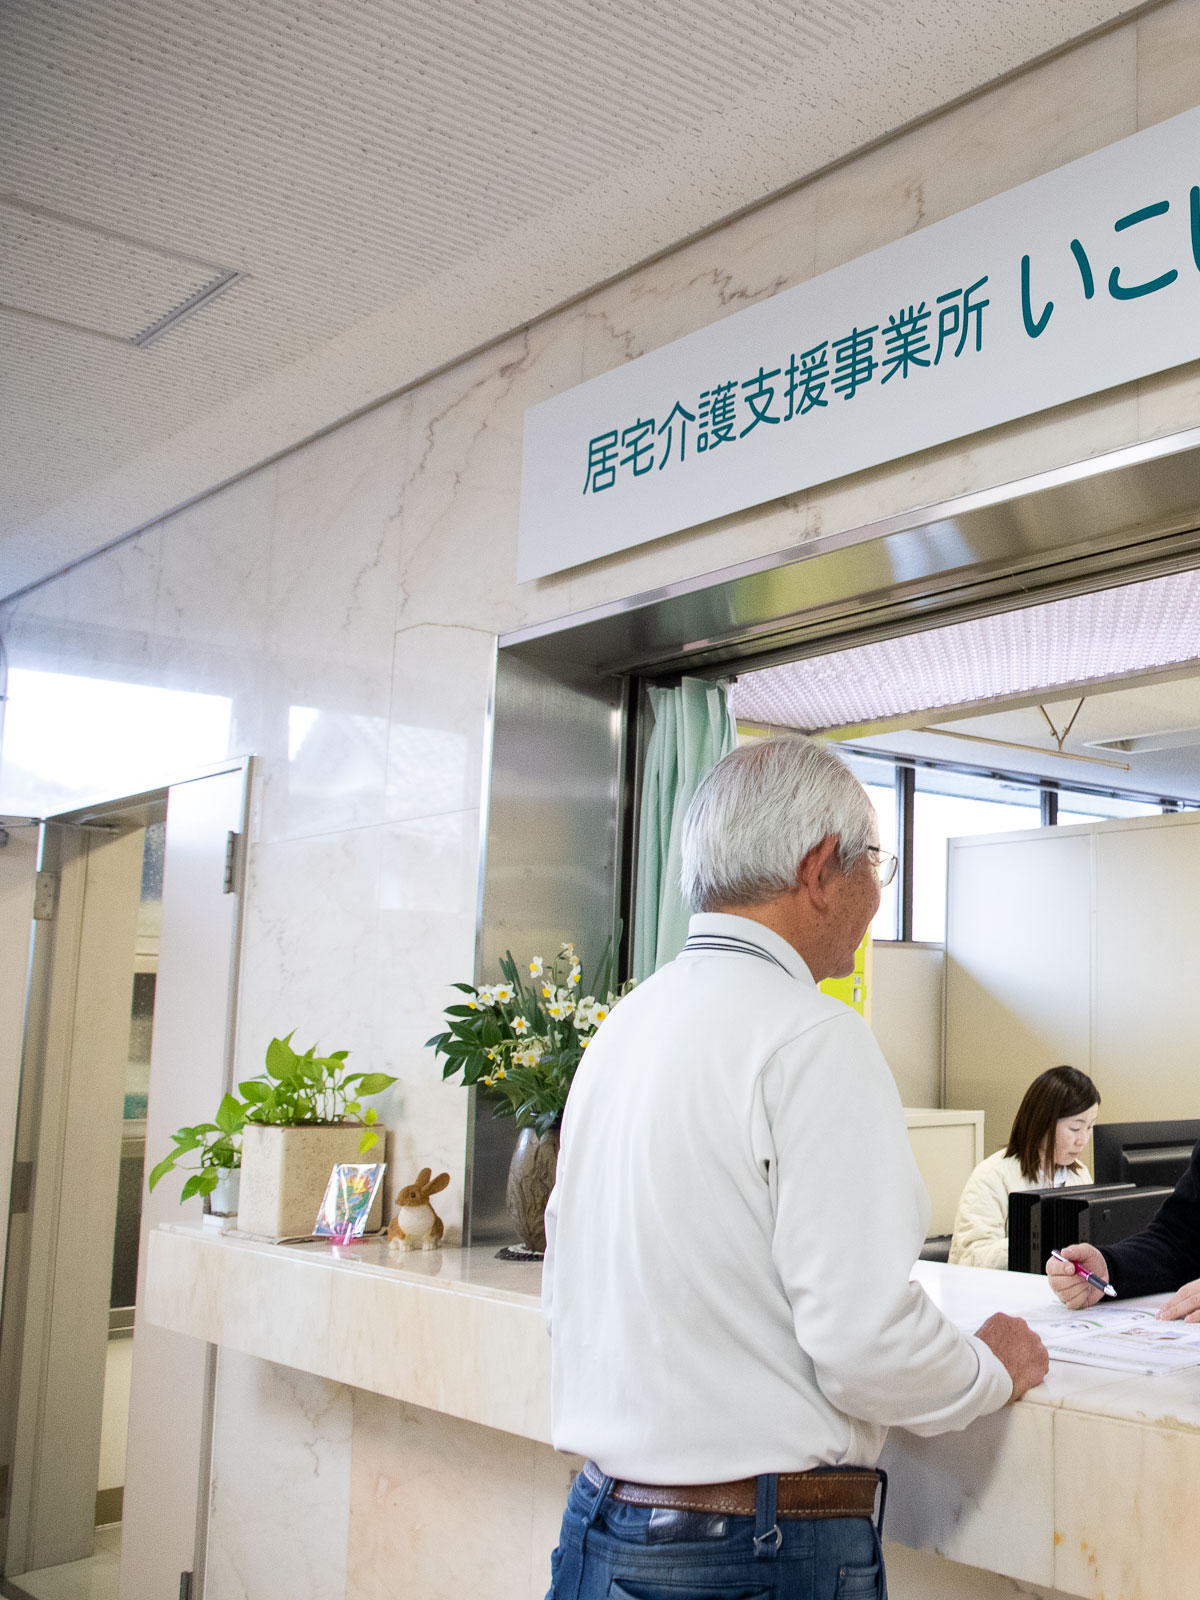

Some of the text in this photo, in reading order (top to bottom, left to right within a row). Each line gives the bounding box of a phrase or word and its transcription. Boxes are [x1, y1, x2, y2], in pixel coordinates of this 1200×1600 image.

[583, 275, 989, 495] 居宅介護支援事業所
